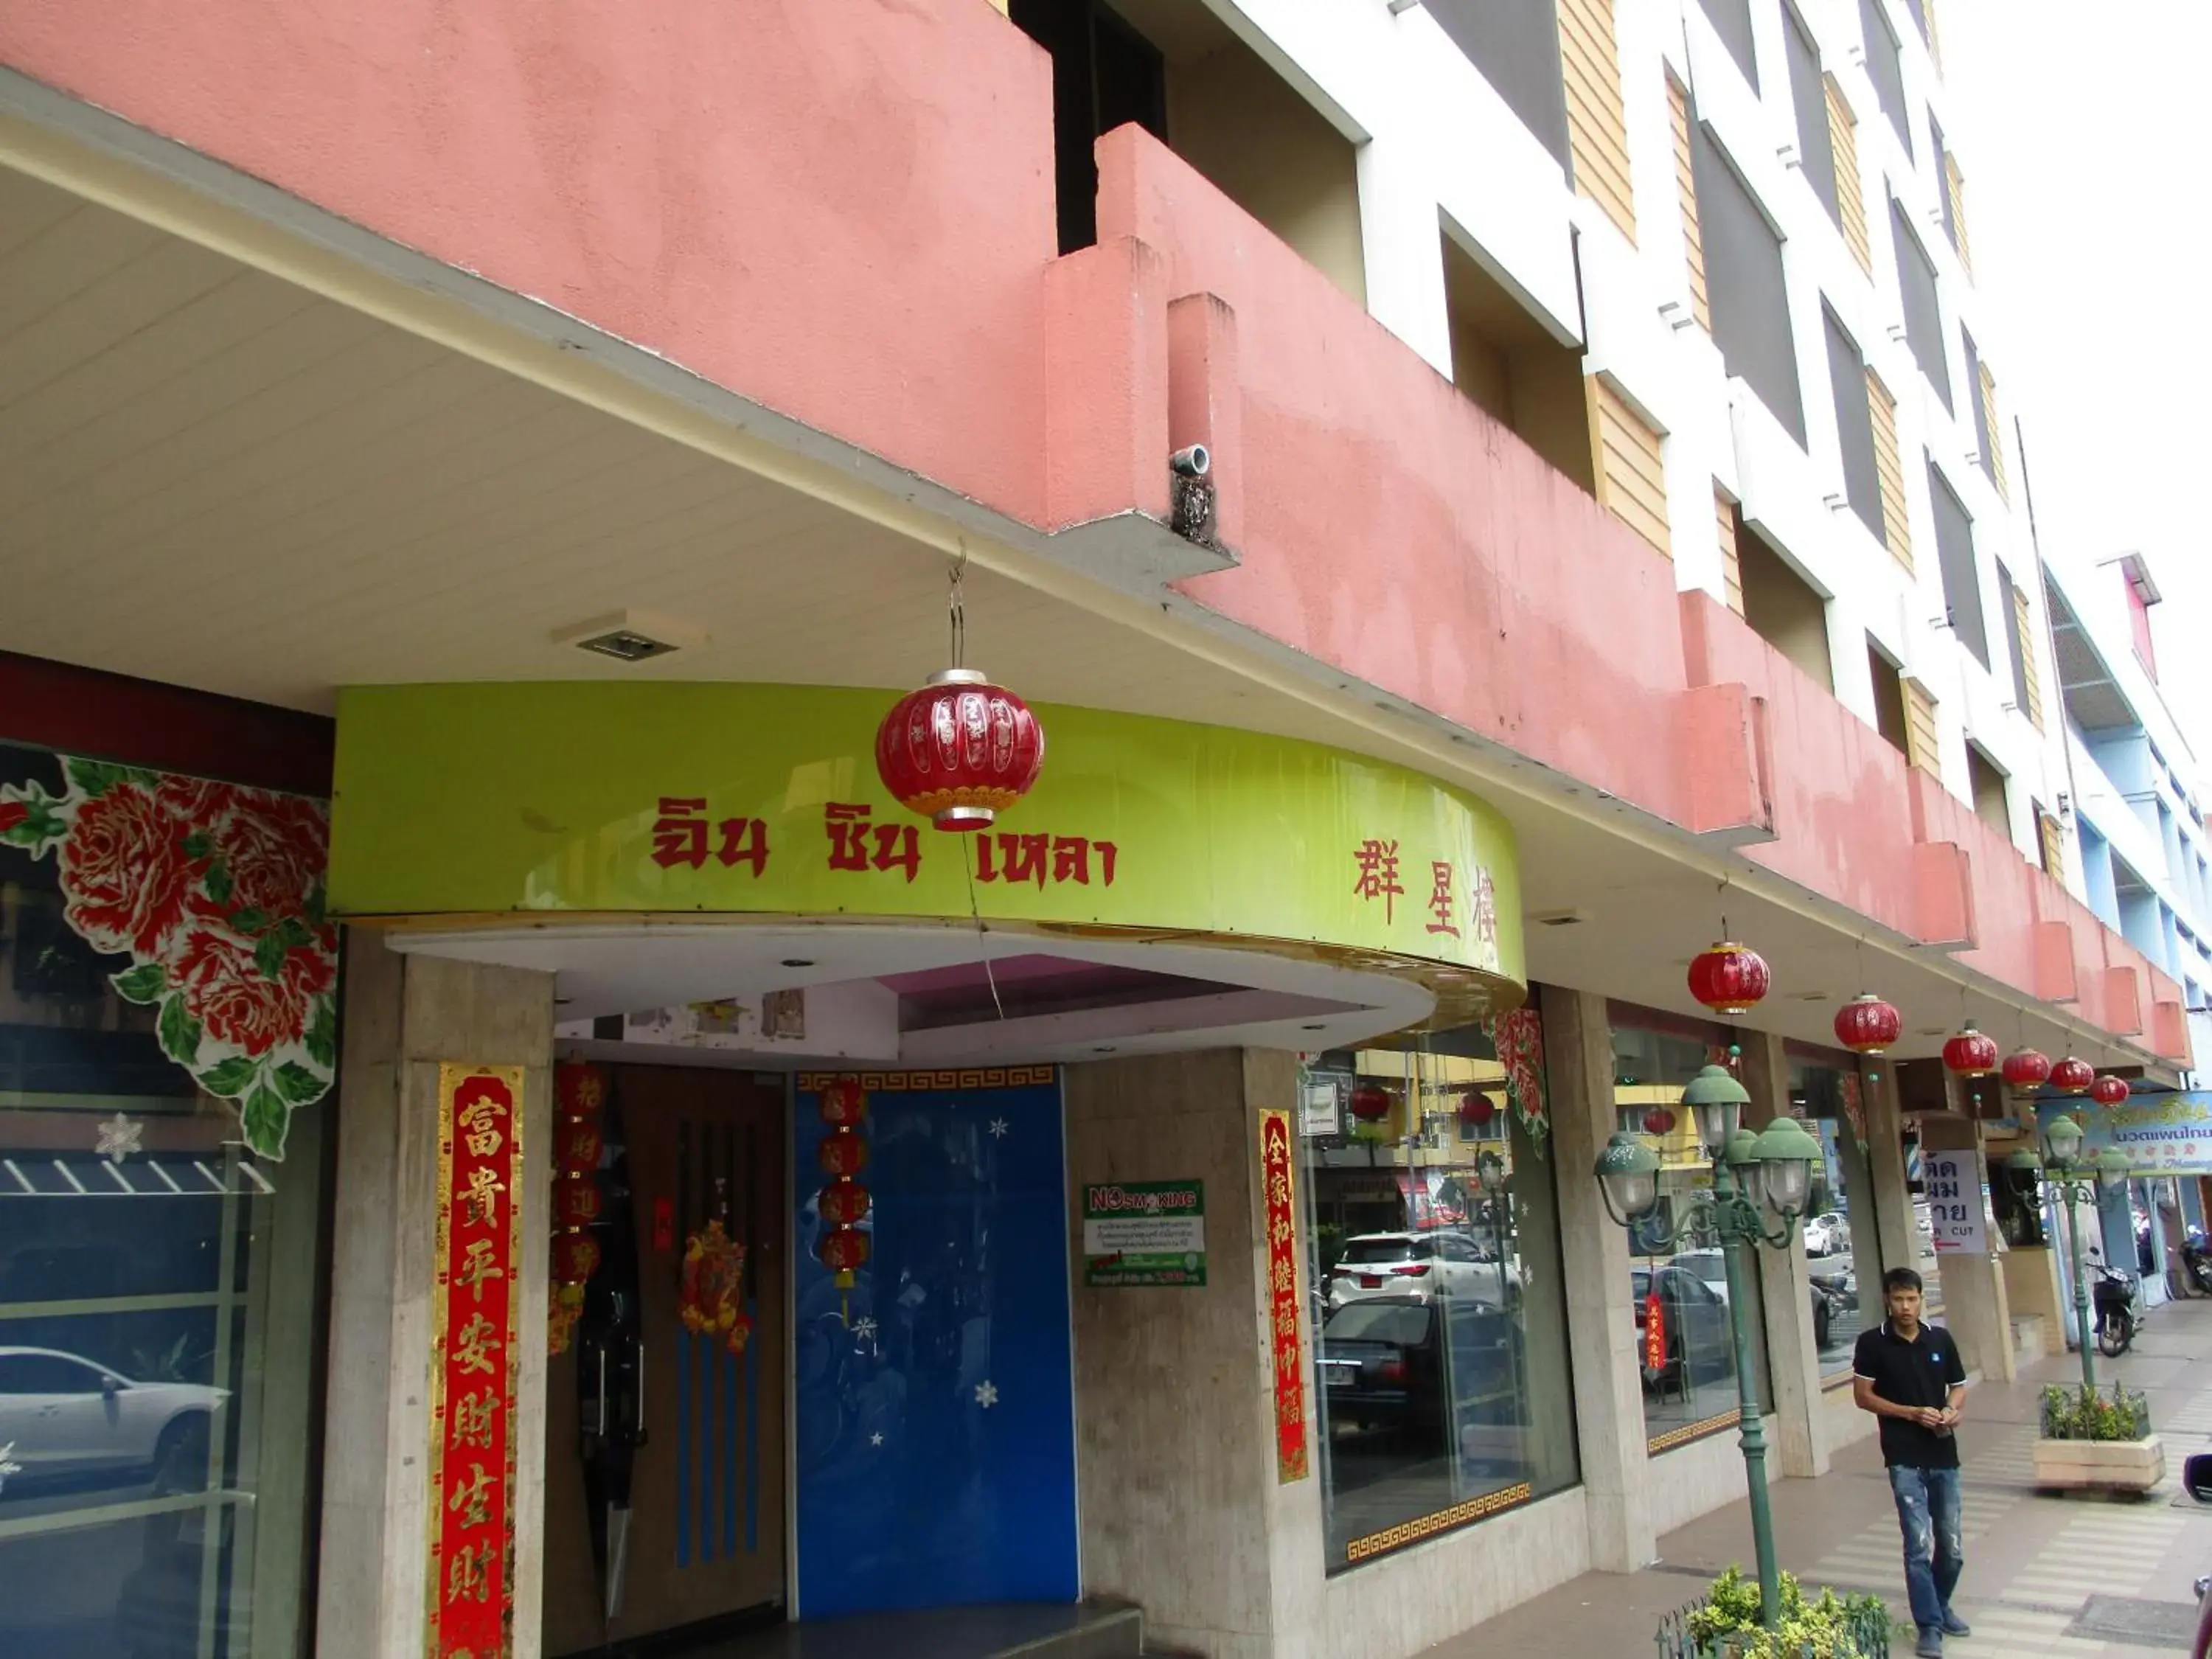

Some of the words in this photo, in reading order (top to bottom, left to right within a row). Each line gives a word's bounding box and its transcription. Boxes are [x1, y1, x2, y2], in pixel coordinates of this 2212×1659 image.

[975, 833, 1119, 892] เหลา
[1089, 1186, 1123, 1211] NO
[1933, 1204, 1968, 1222] าย
[1951, 1226, 1974, 1237] CUT
[446, 1094, 508, 1605] 富貴平安財生財
